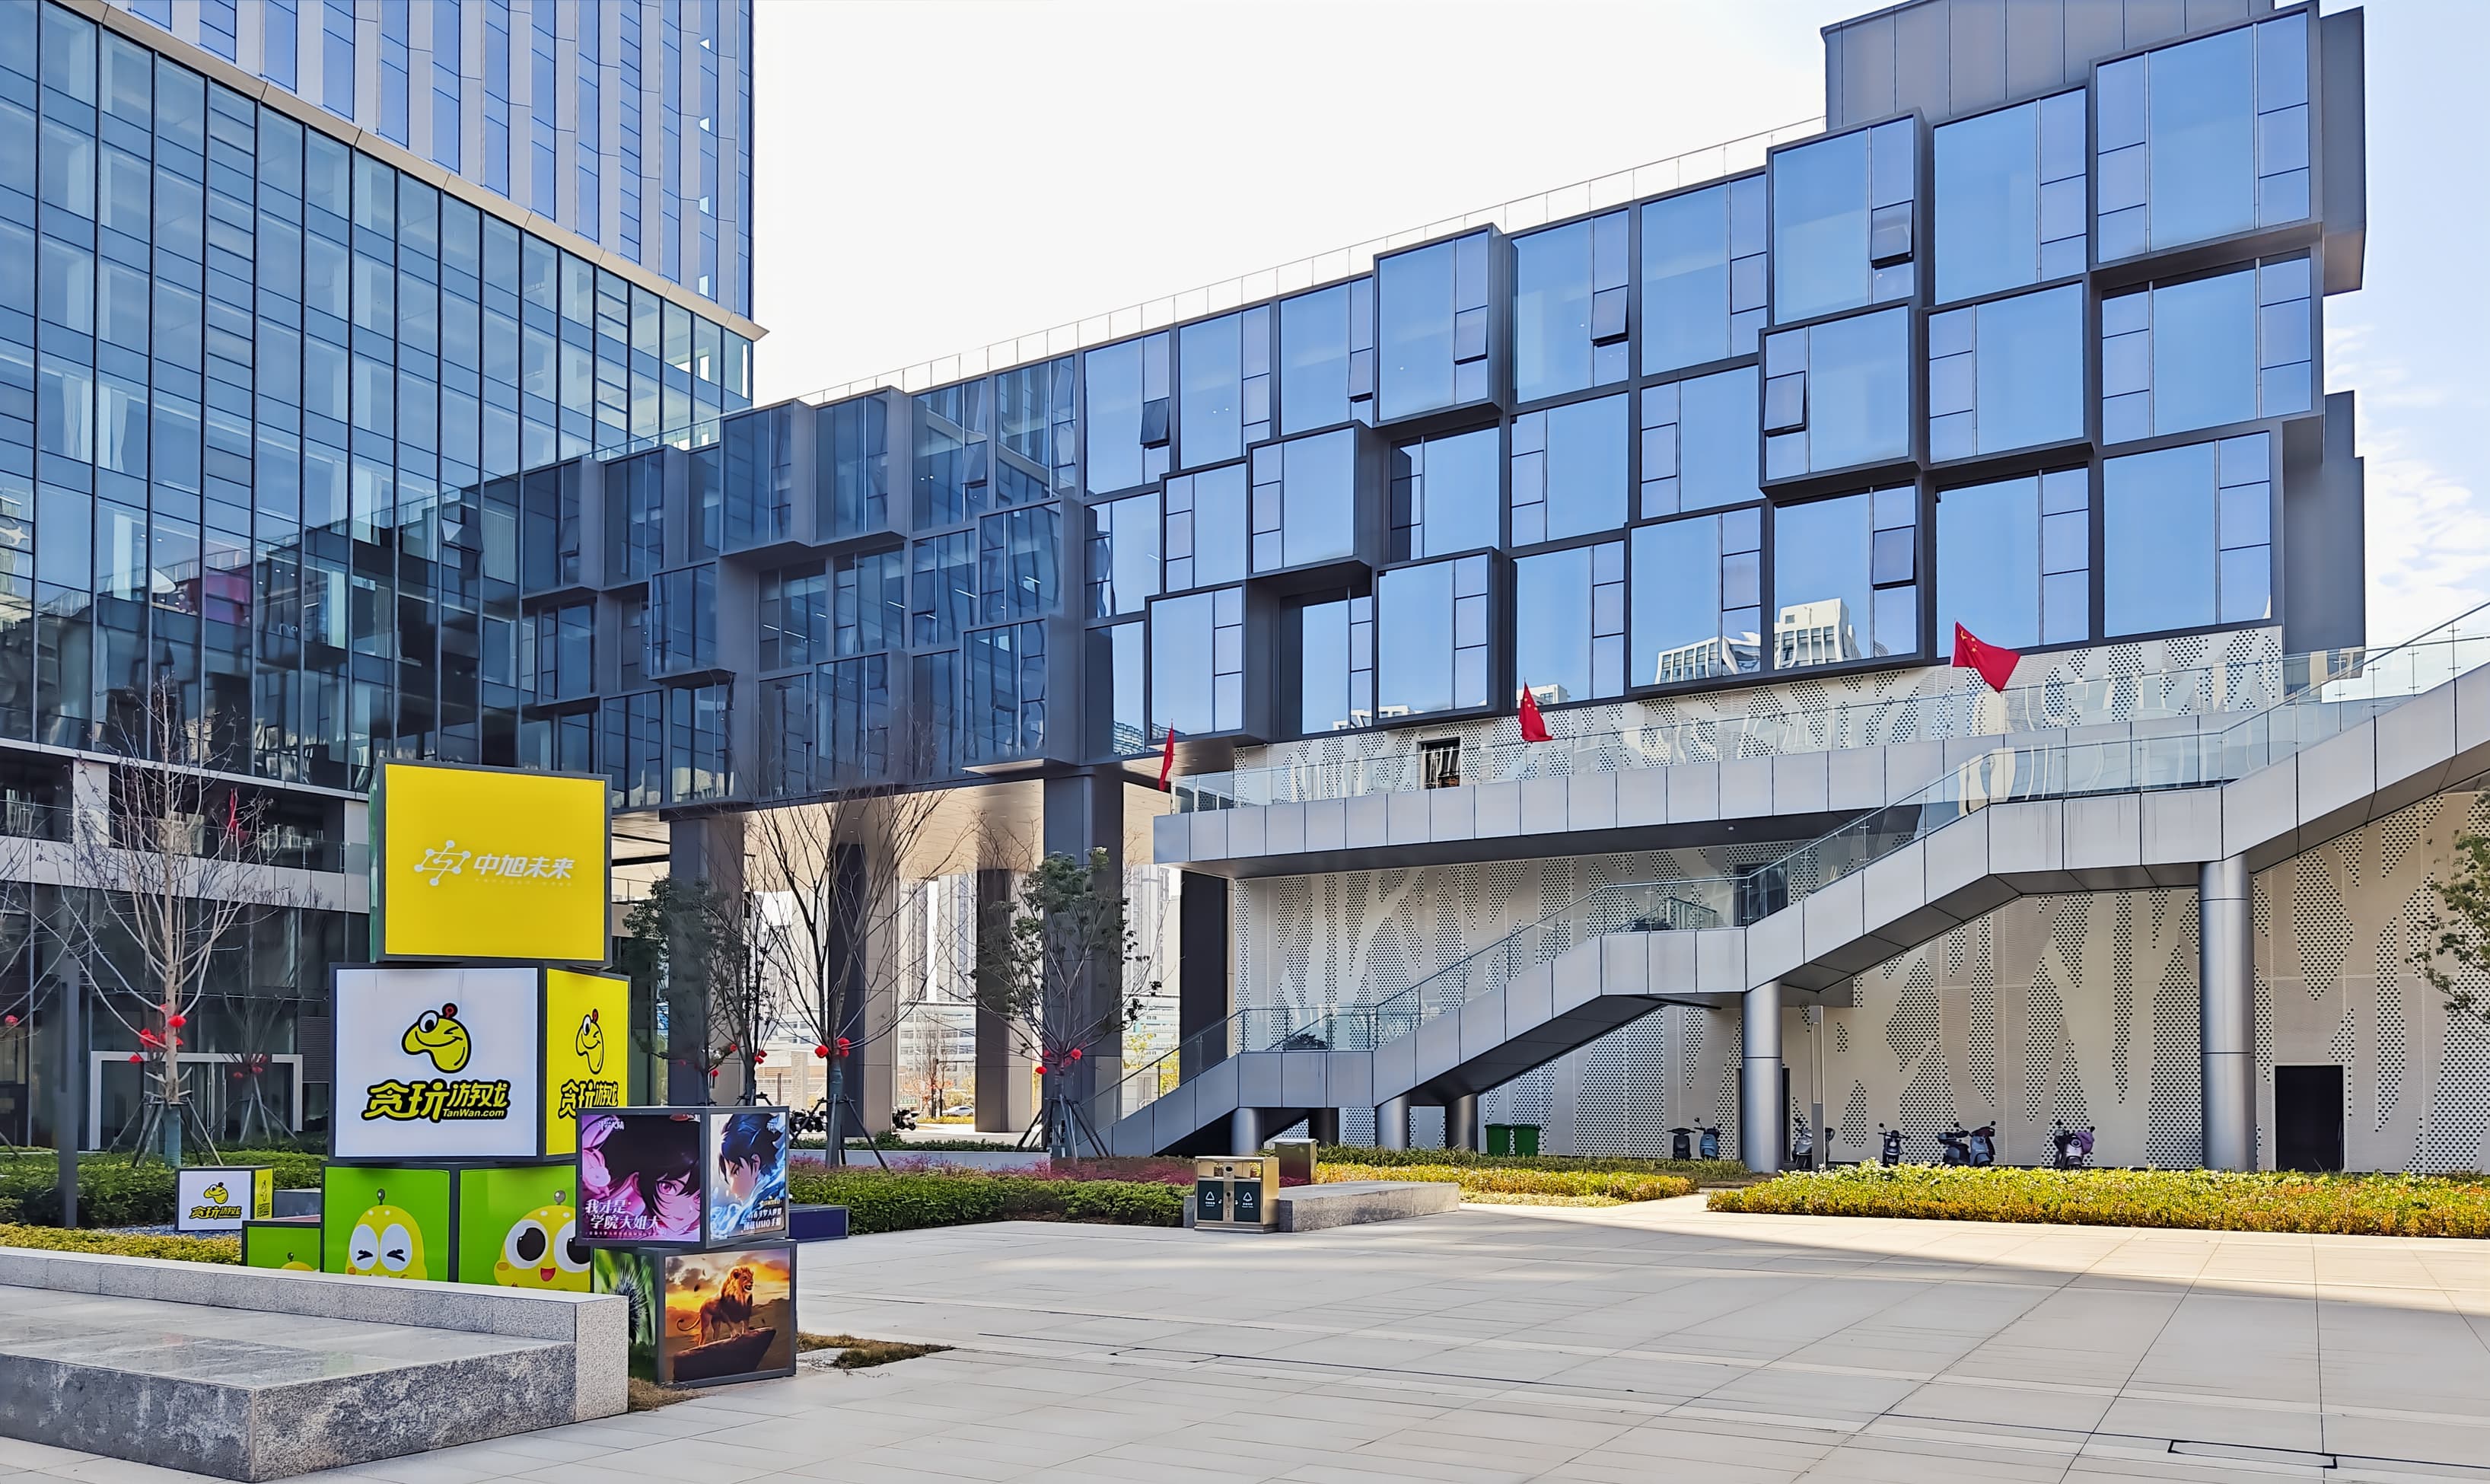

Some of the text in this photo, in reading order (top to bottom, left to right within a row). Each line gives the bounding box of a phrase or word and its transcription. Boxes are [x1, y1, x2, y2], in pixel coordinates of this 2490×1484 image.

[473, 853, 575, 879] 中旭未来
[362, 1079, 511, 1123] 贪玩游戏
[443, 1108, 505, 1118] TanWan.com
[585, 1199, 626, 1214] 我才是
